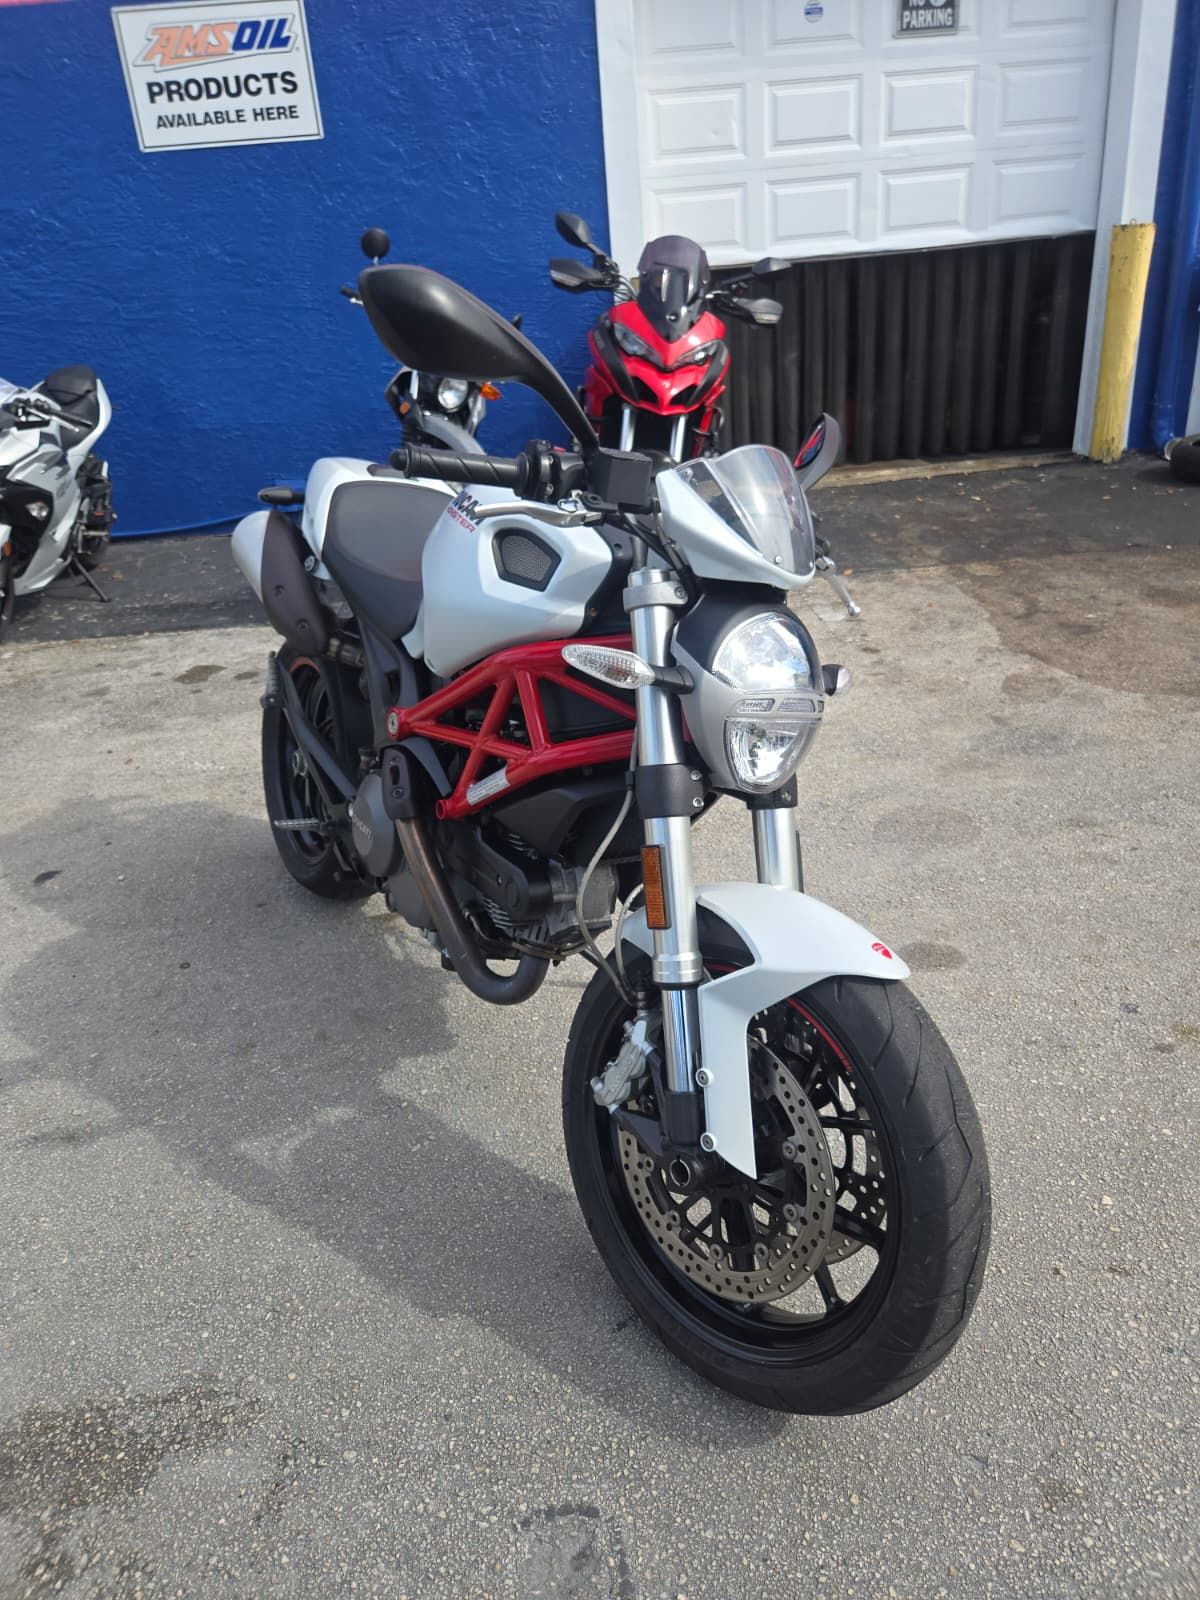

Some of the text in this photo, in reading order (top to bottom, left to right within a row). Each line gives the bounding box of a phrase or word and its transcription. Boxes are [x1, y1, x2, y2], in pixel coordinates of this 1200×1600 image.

[902, 8, 953, 29] PARKING
[143, 18, 292, 67] AMSOIL
[146, 71, 298, 104] PRODUCTS
[156, 105, 299, 130] AVAILABLE HERE
